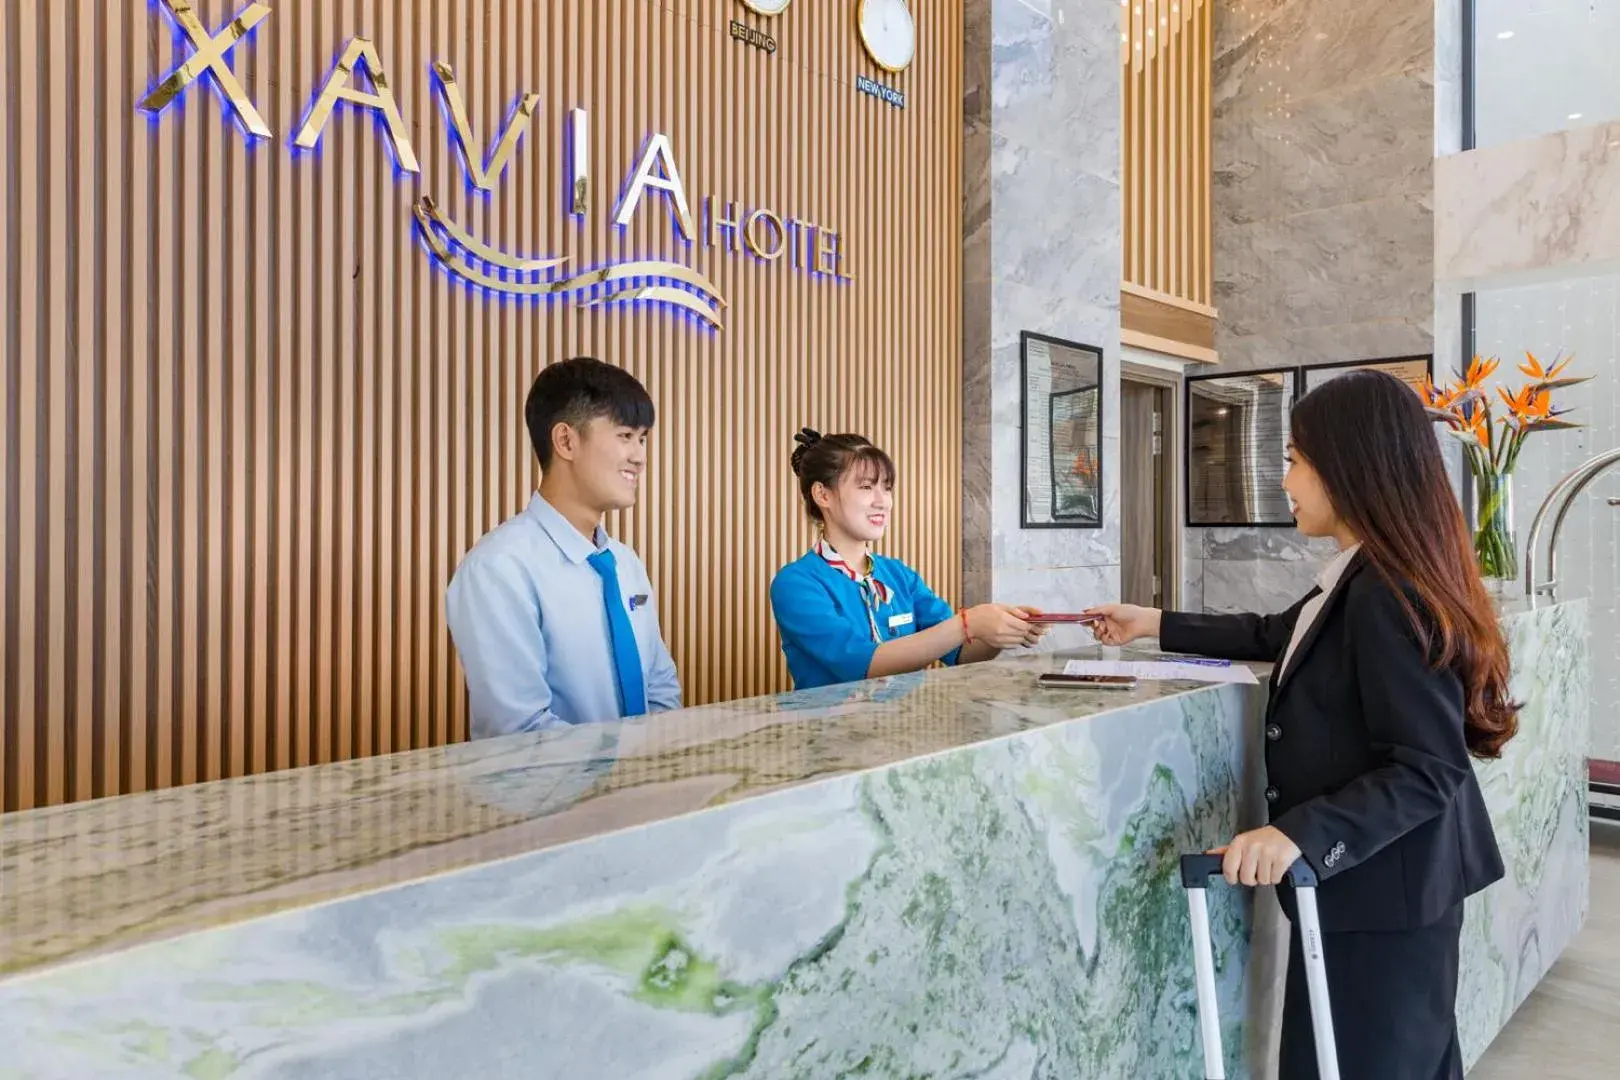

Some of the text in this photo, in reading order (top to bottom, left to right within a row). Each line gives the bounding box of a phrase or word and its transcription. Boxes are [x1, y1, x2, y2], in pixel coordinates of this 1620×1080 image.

[730, 20, 776, 53] BEIJING
[857, 76, 904, 107] NEW YORK
[138, 0, 857, 283] XAVIA HOTEL
